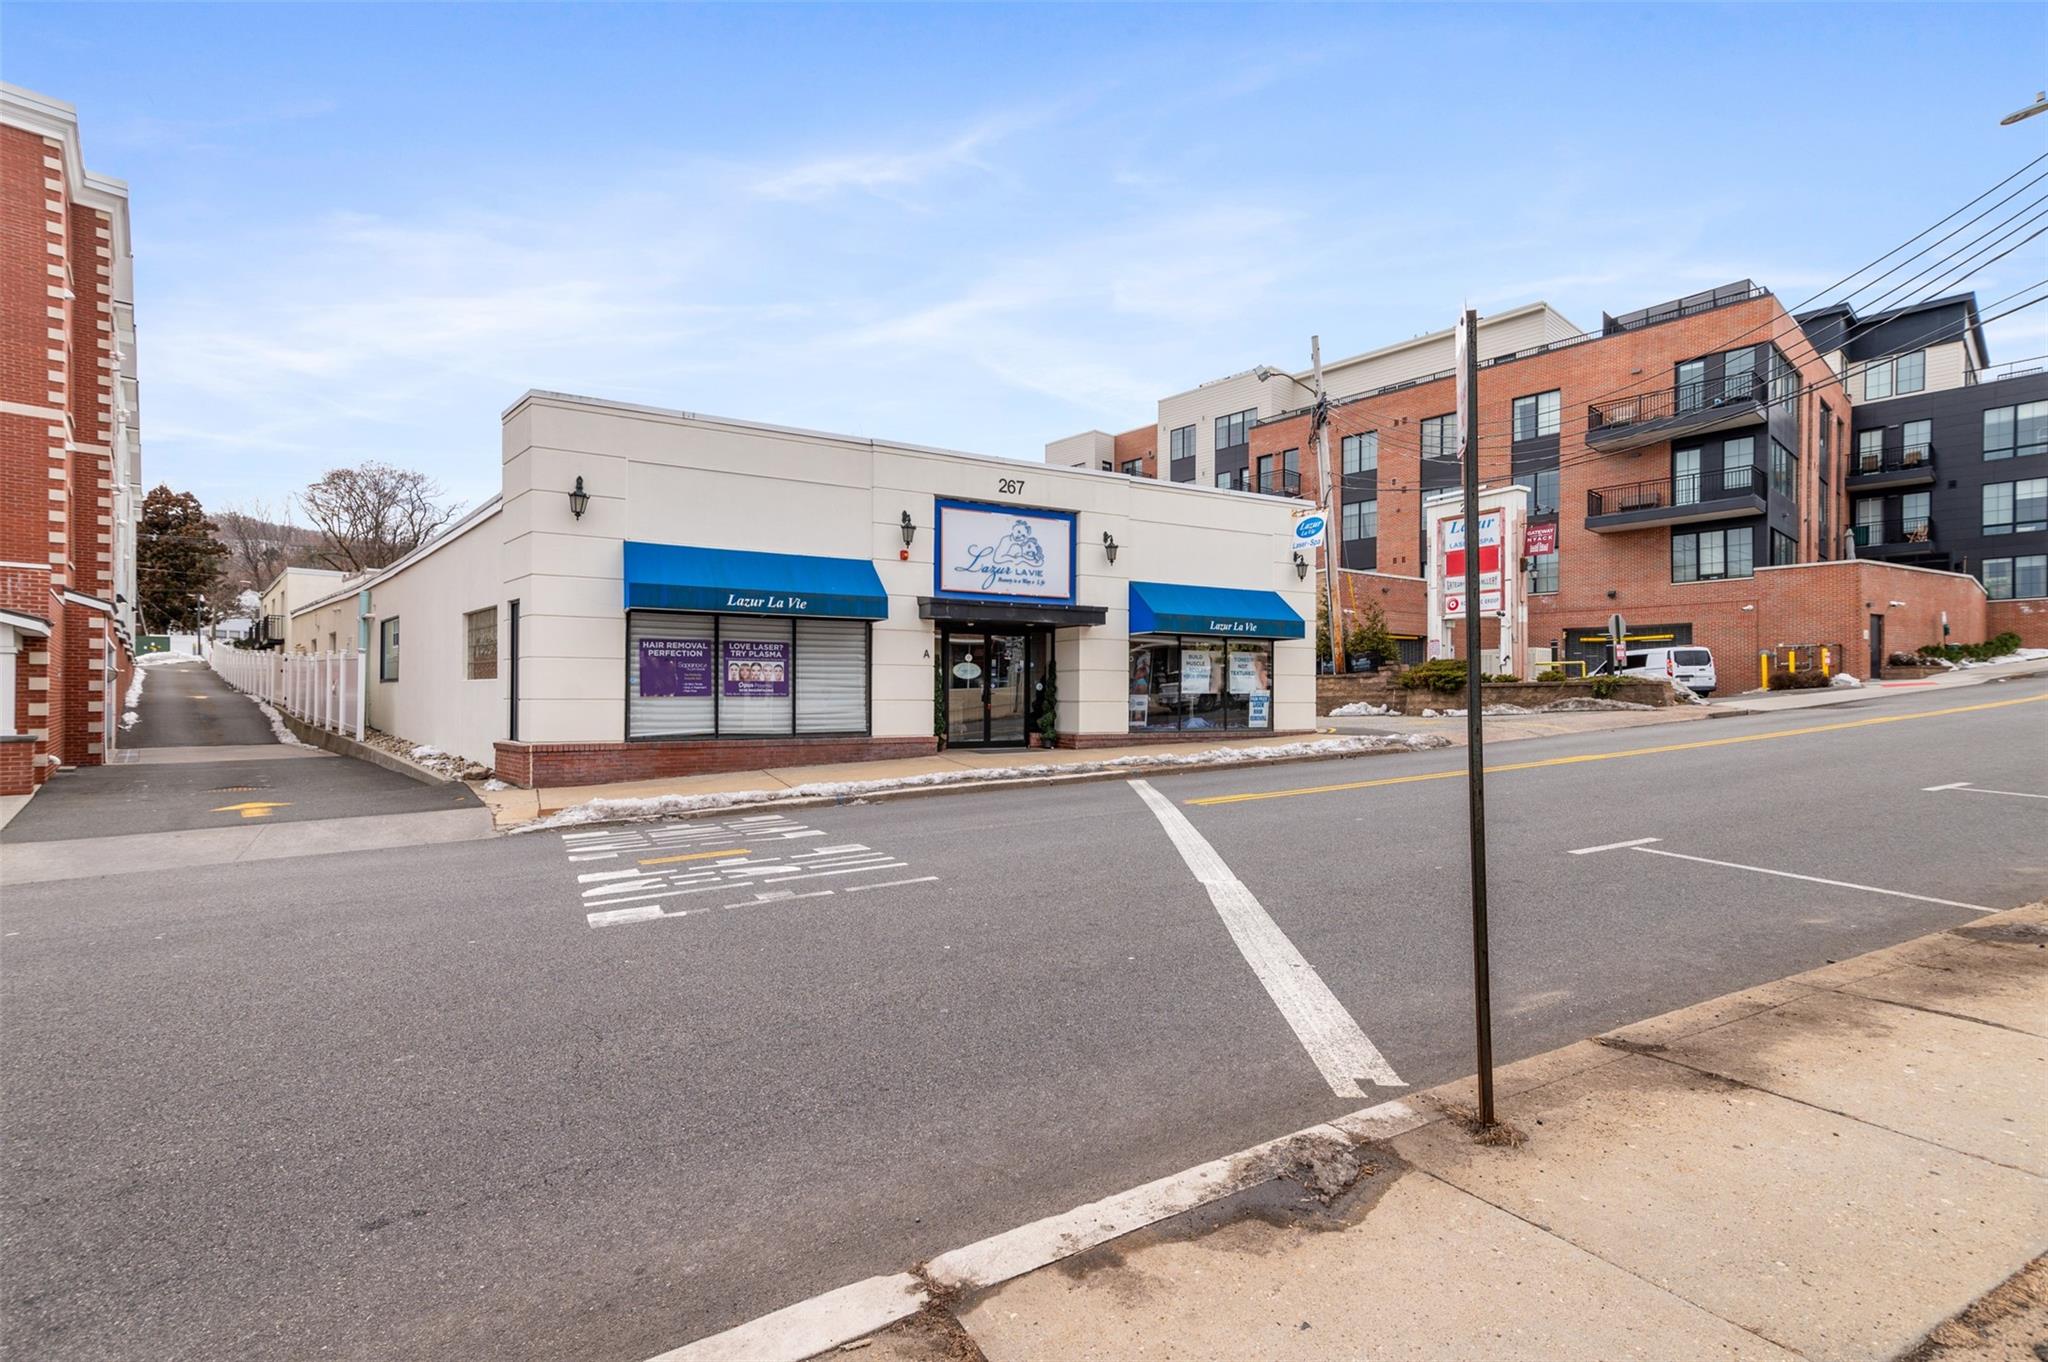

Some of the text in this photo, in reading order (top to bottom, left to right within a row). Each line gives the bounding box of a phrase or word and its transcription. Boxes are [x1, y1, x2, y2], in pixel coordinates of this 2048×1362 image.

[998, 478, 1025, 495] 267
[1450, 518, 1495, 533] Lur
[1527, 528, 1553, 536] GATEWAY
[954, 544, 1012, 590] Lazur
[727, 594, 807, 610] Lazur La Vie
[1210, 620, 1258, 632] Lazur La Vie
[642, 641, 709, 650] HAIR REMOVAL
[728, 642, 784, 651] LOVE LASER?
[648, 649, 703, 657] PERFECTION
[748, 650, 782, 658] PLASMA
[923, 649, 931, 658] A
